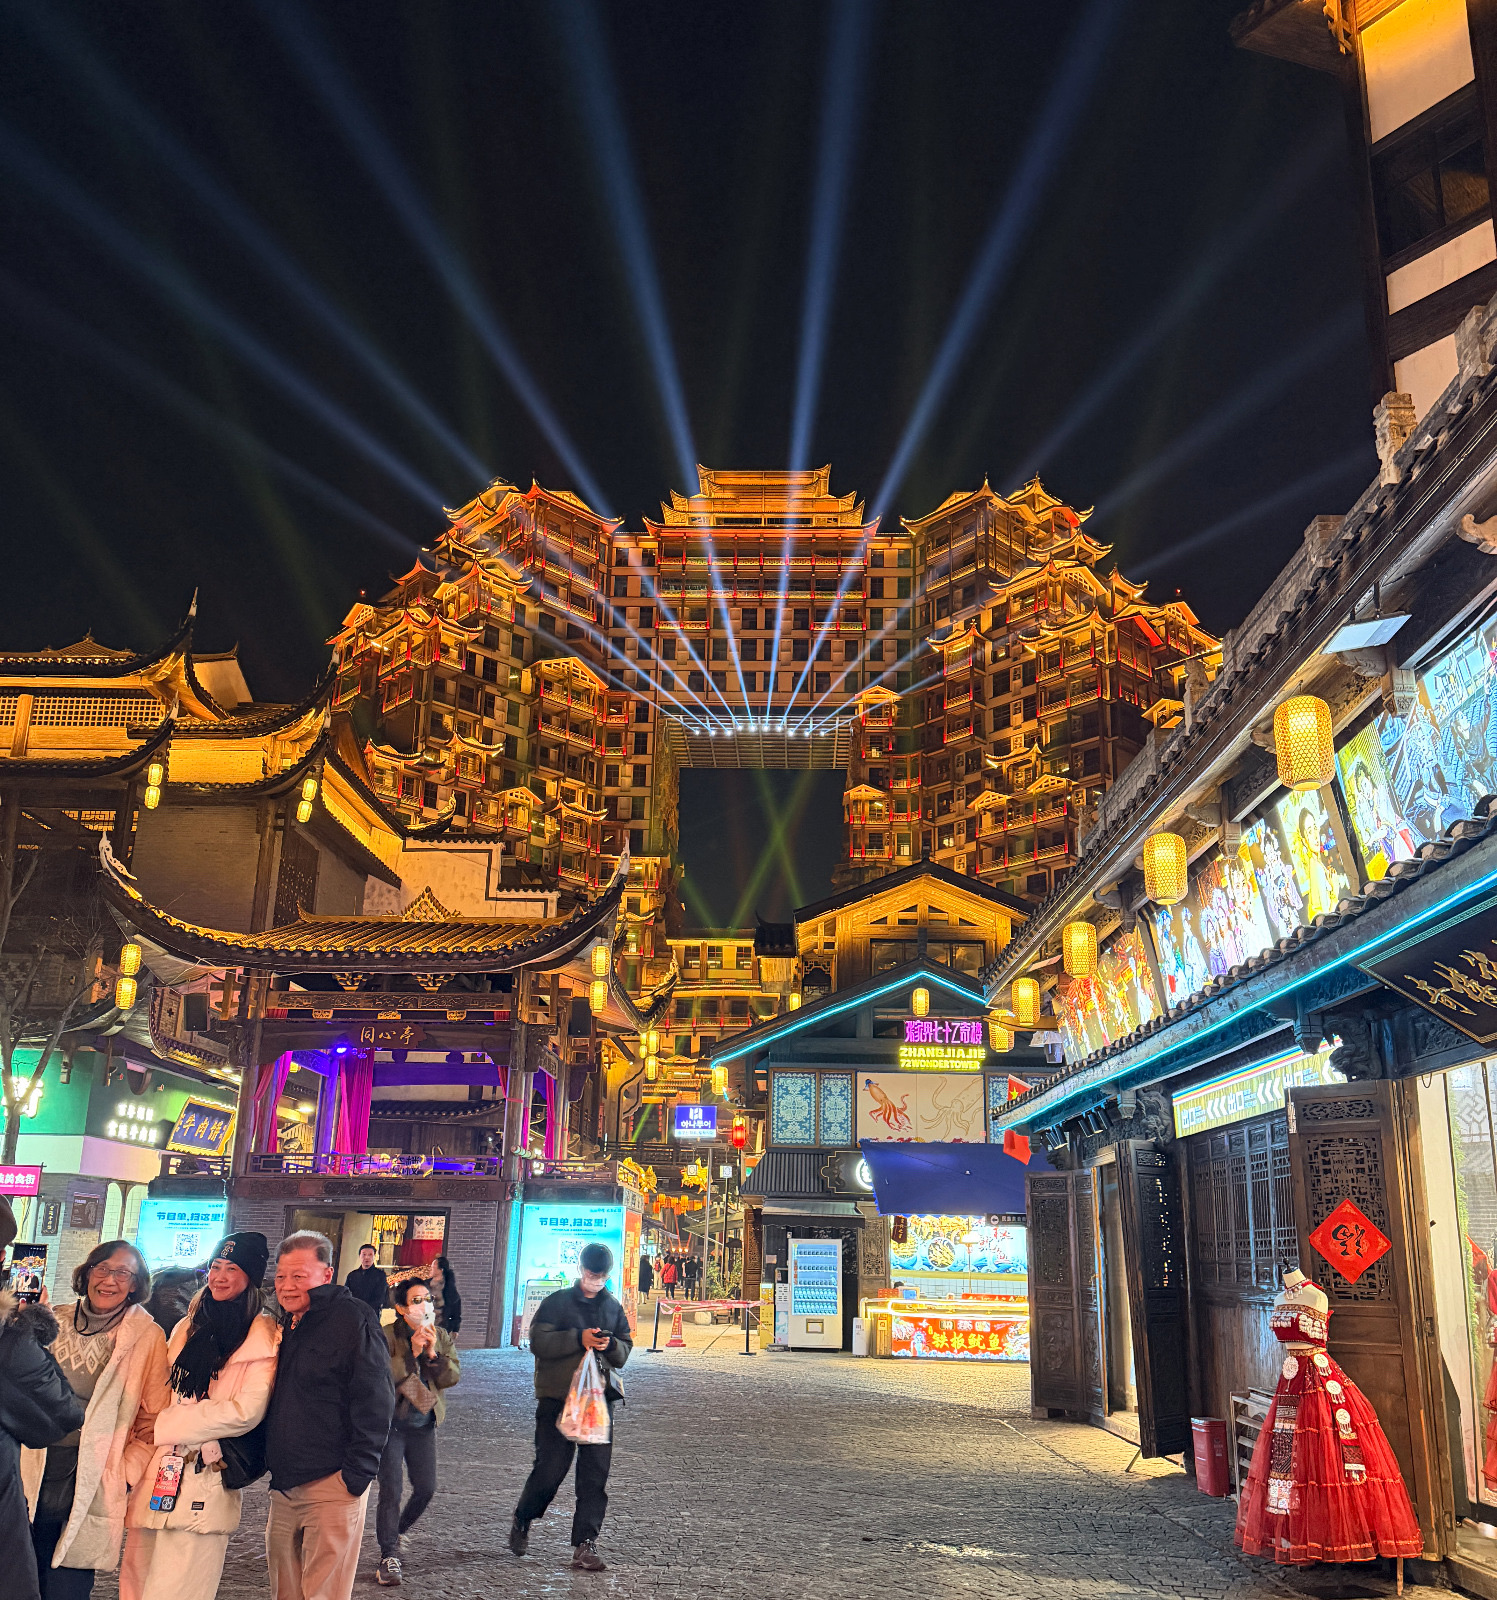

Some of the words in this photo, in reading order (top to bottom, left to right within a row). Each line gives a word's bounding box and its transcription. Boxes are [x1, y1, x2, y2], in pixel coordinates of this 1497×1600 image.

[361, 1026, 414, 1044] 同心亭
[899, 1047, 986, 1059] ZHANGJIAJIE
[681, 1120, 711, 1128] 하나투어
[1332, 1224, 1366, 1258] 福
[932, 1331, 1003, 1350] 铁板鱿鱼
